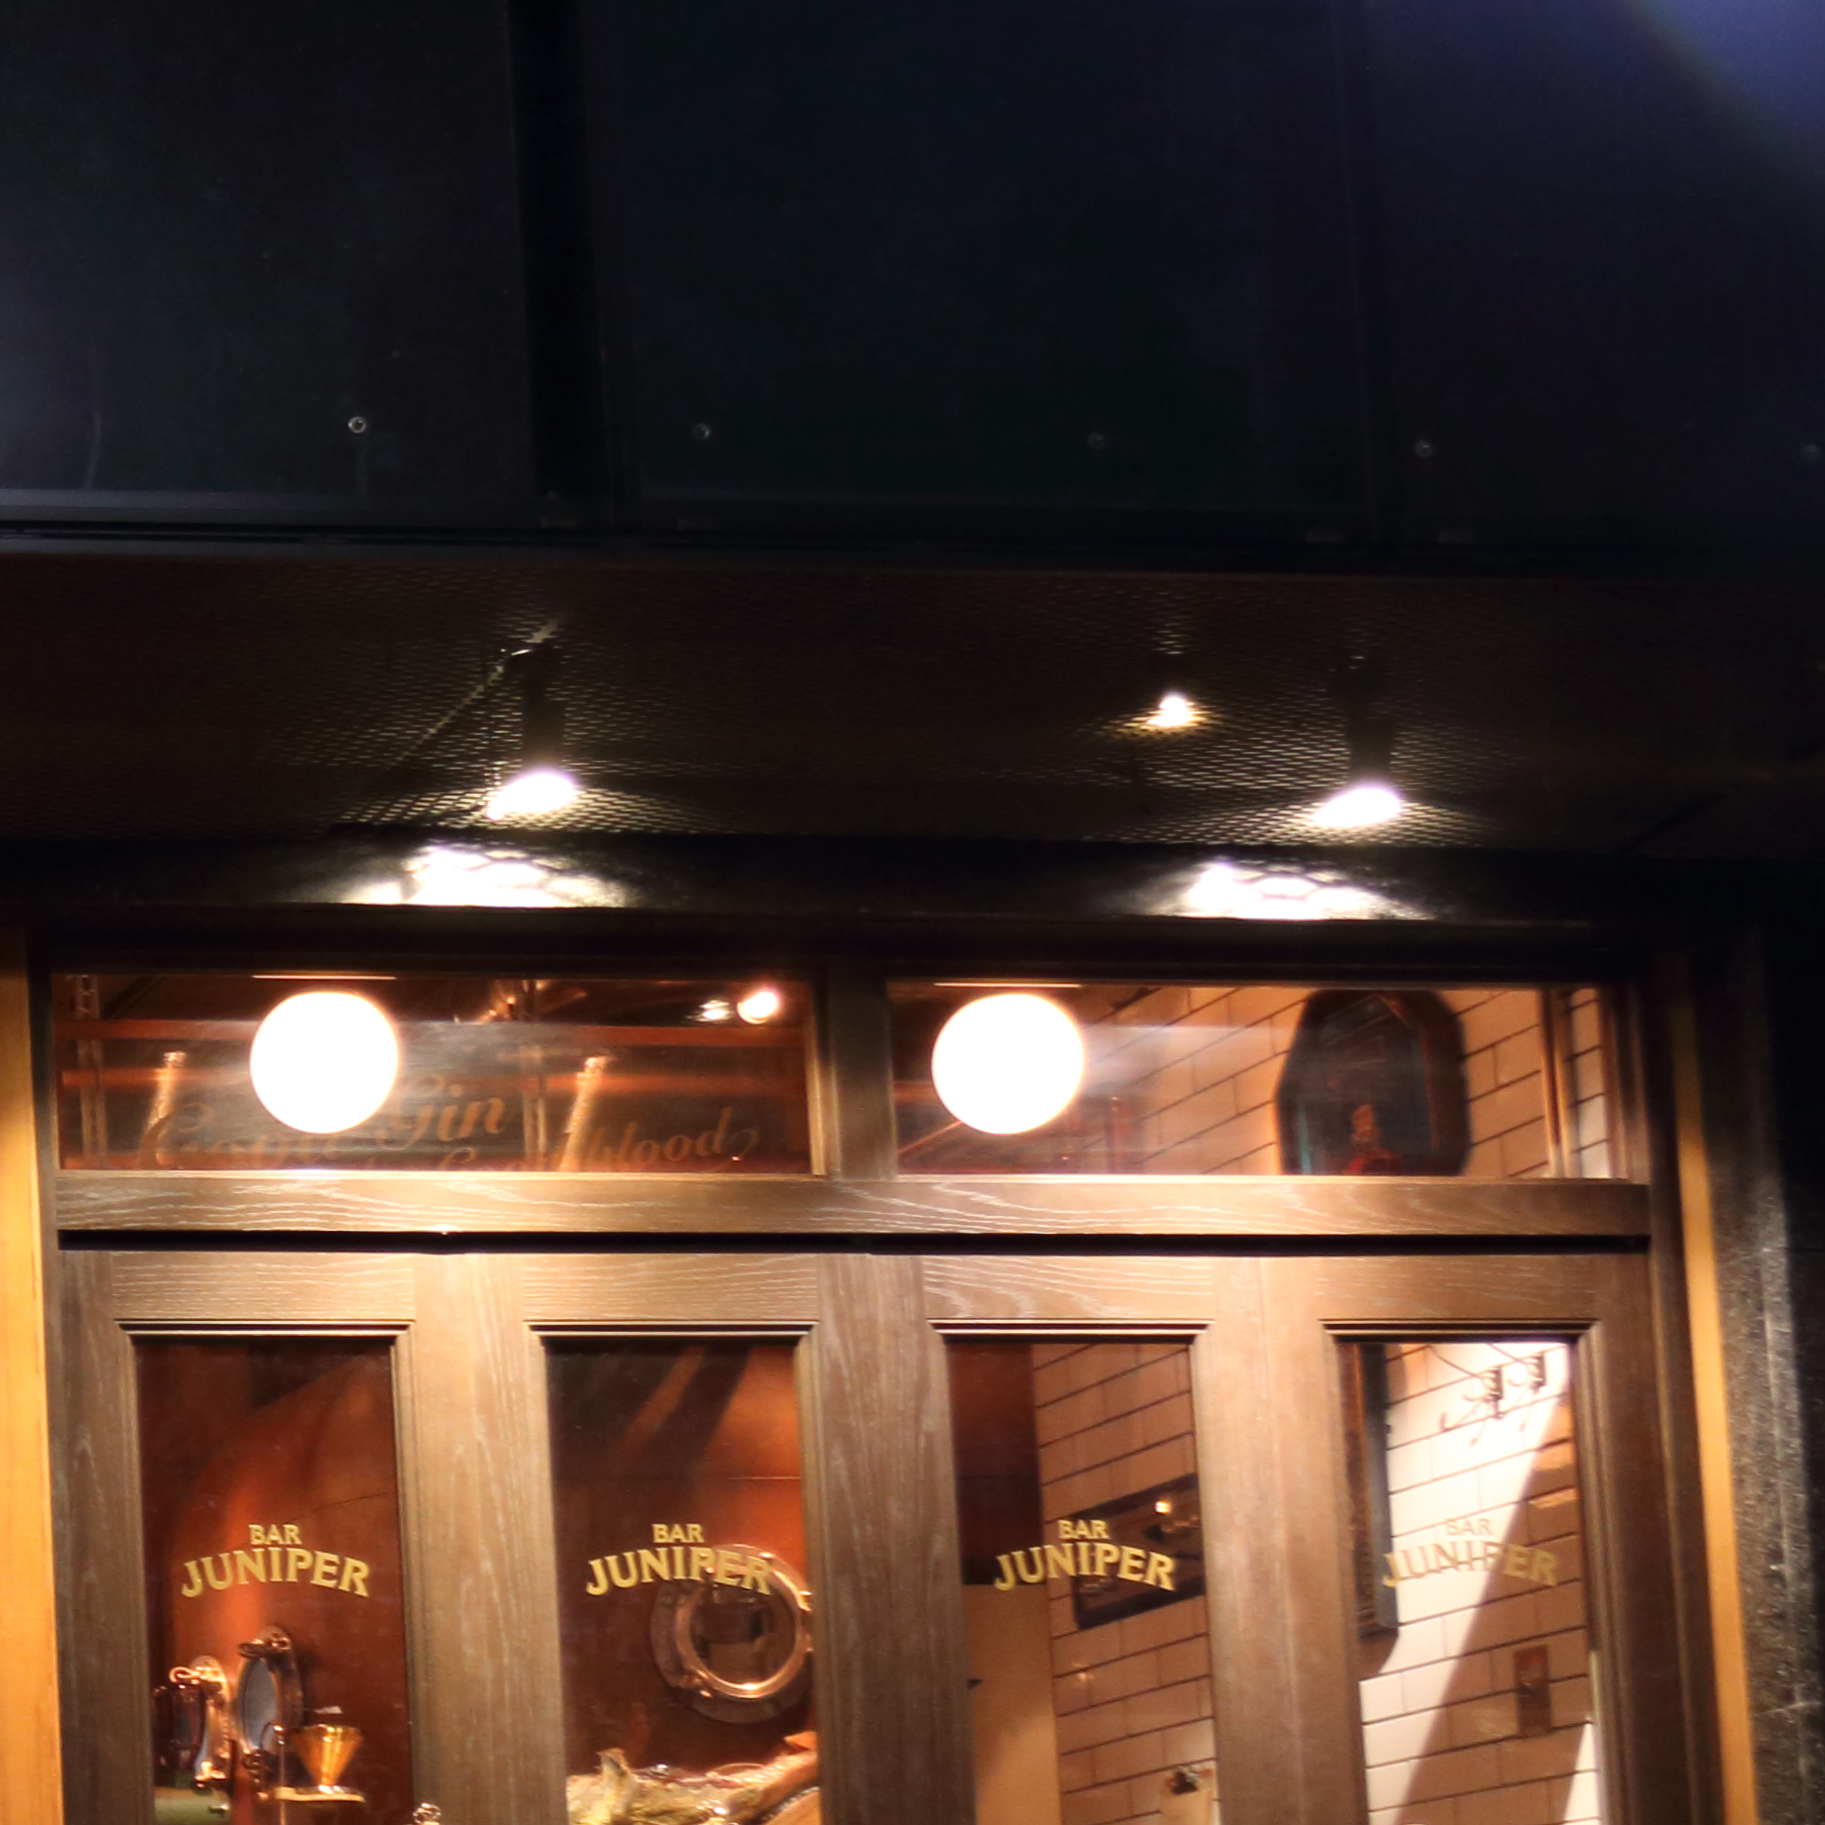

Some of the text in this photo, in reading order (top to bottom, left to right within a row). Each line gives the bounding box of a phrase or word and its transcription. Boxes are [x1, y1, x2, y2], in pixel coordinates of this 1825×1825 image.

[248, 1524, 302, 1545] BAR
[652, 1523, 704, 1543] BAR
[1058, 1519, 1110, 1539] BAR
[1445, 1518, 1494, 1536] BAR
[181, 1547, 370, 1597] JUNIPER
[586, 1546, 772, 1596] JUNIPER
[994, 1542, 1176, 1591] JUNIPER
[1382, 1540, 1557, 1587] JUNIPER
